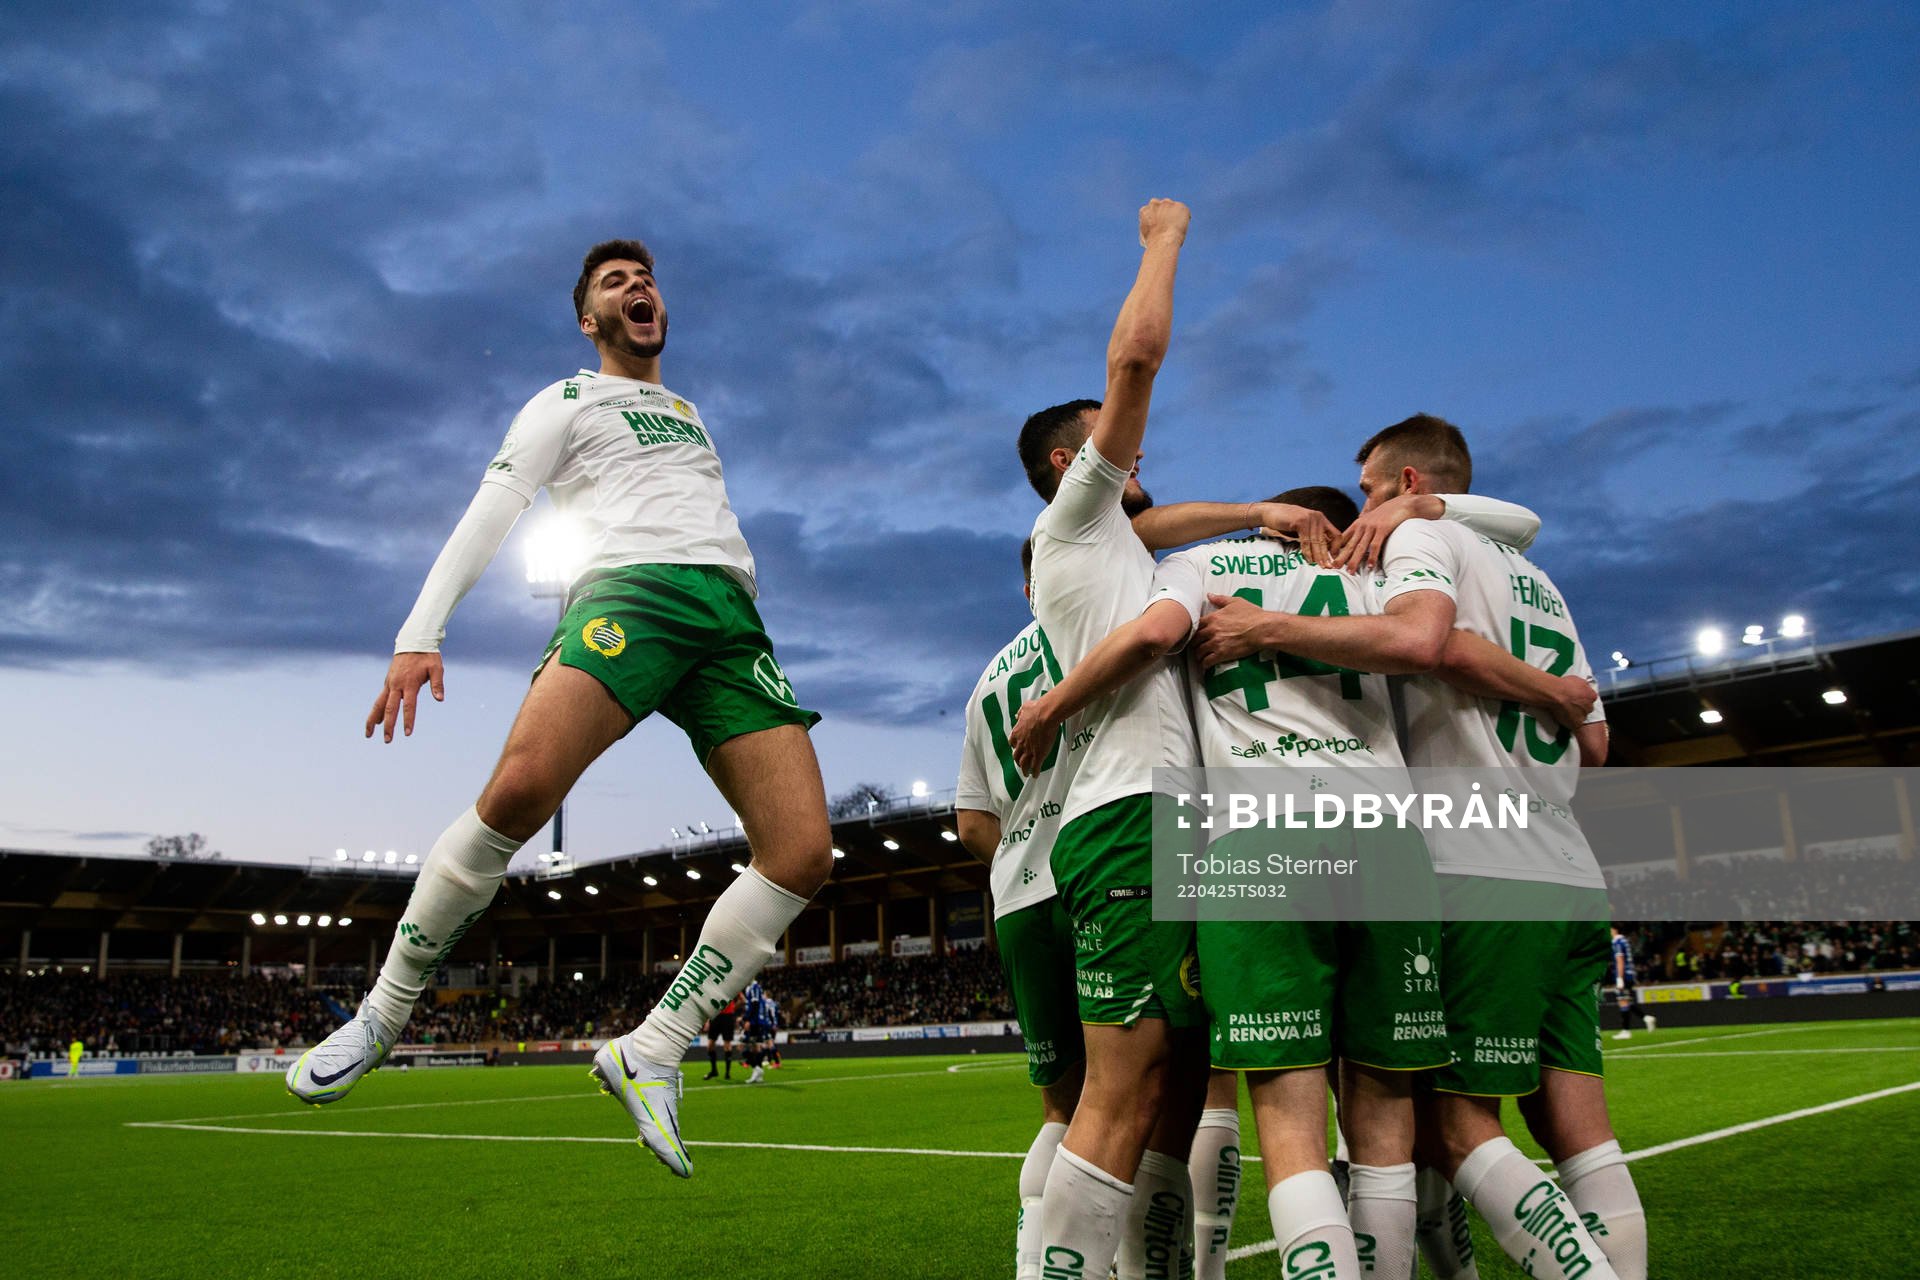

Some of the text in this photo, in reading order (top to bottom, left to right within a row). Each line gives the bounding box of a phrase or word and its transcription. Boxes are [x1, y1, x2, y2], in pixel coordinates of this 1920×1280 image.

[636, 433, 698, 446] CHOCOL
[1229, 1009, 1321, 1025] PALLSERVICE
[1394, 1011, 1444, 1024] PALLSER
[1229, 1023, 1323, 1042] RENOVA AB
[1475, 1036, 1539, 1049] PALLSERV
